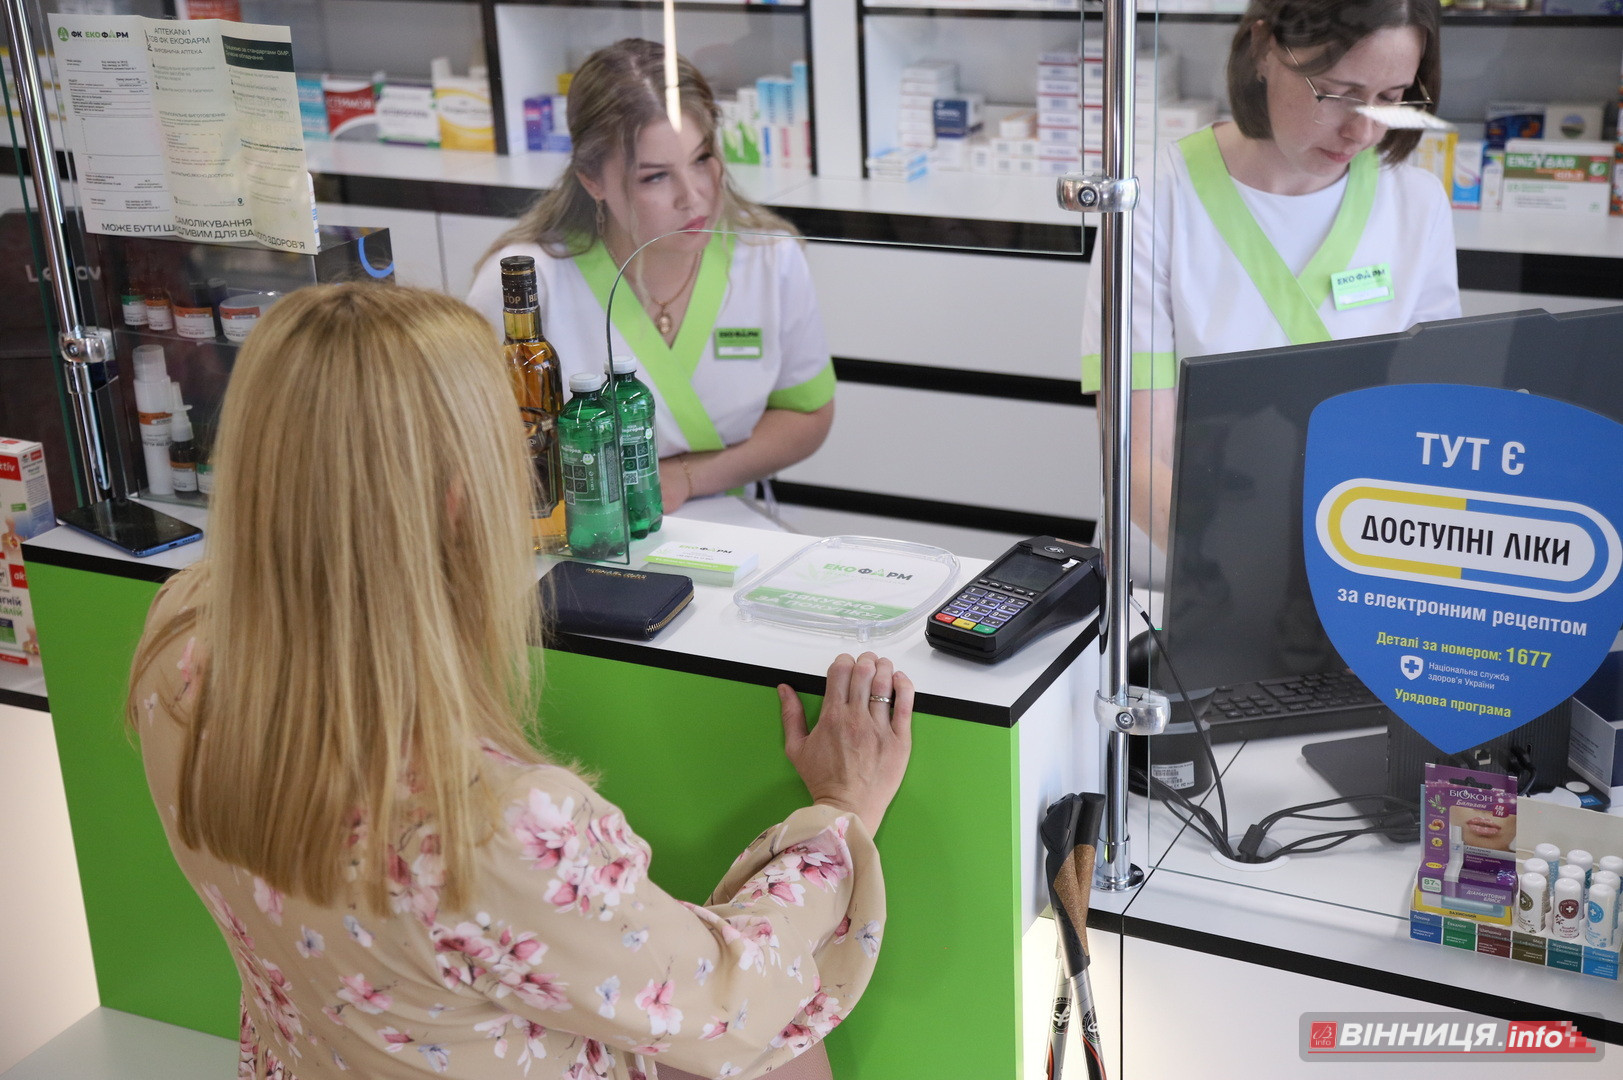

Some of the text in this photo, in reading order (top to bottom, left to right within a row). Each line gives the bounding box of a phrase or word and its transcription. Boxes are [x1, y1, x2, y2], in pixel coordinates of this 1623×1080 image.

[85, 28, 129, 38] ЕКОФАРМ
[170, 37, 211, 45] ЕКОФАРМ
[101, 223, 132, 233] МОЖЕ
[133, 224, 162, 233] БУТИ
[214, 229, 240, 239] ДЛЯ
[1416, 431, 1526, 476] ТУТ Є
[1361, 515, 1571, 566] ДОСТУПНІ ЛІКИ
[823, 563, 913, 581] ЕКОФАРМ
[1337, 588, 1588, 637] за електронним рецептом
[1376, 631, 1552, 668] Деталі за номером: 1677
[1429, 662, 1510, 682] Національна служба
[1465, 678, 1495, 690] України
[1395, 688, 1512, 718] Урядова програма
